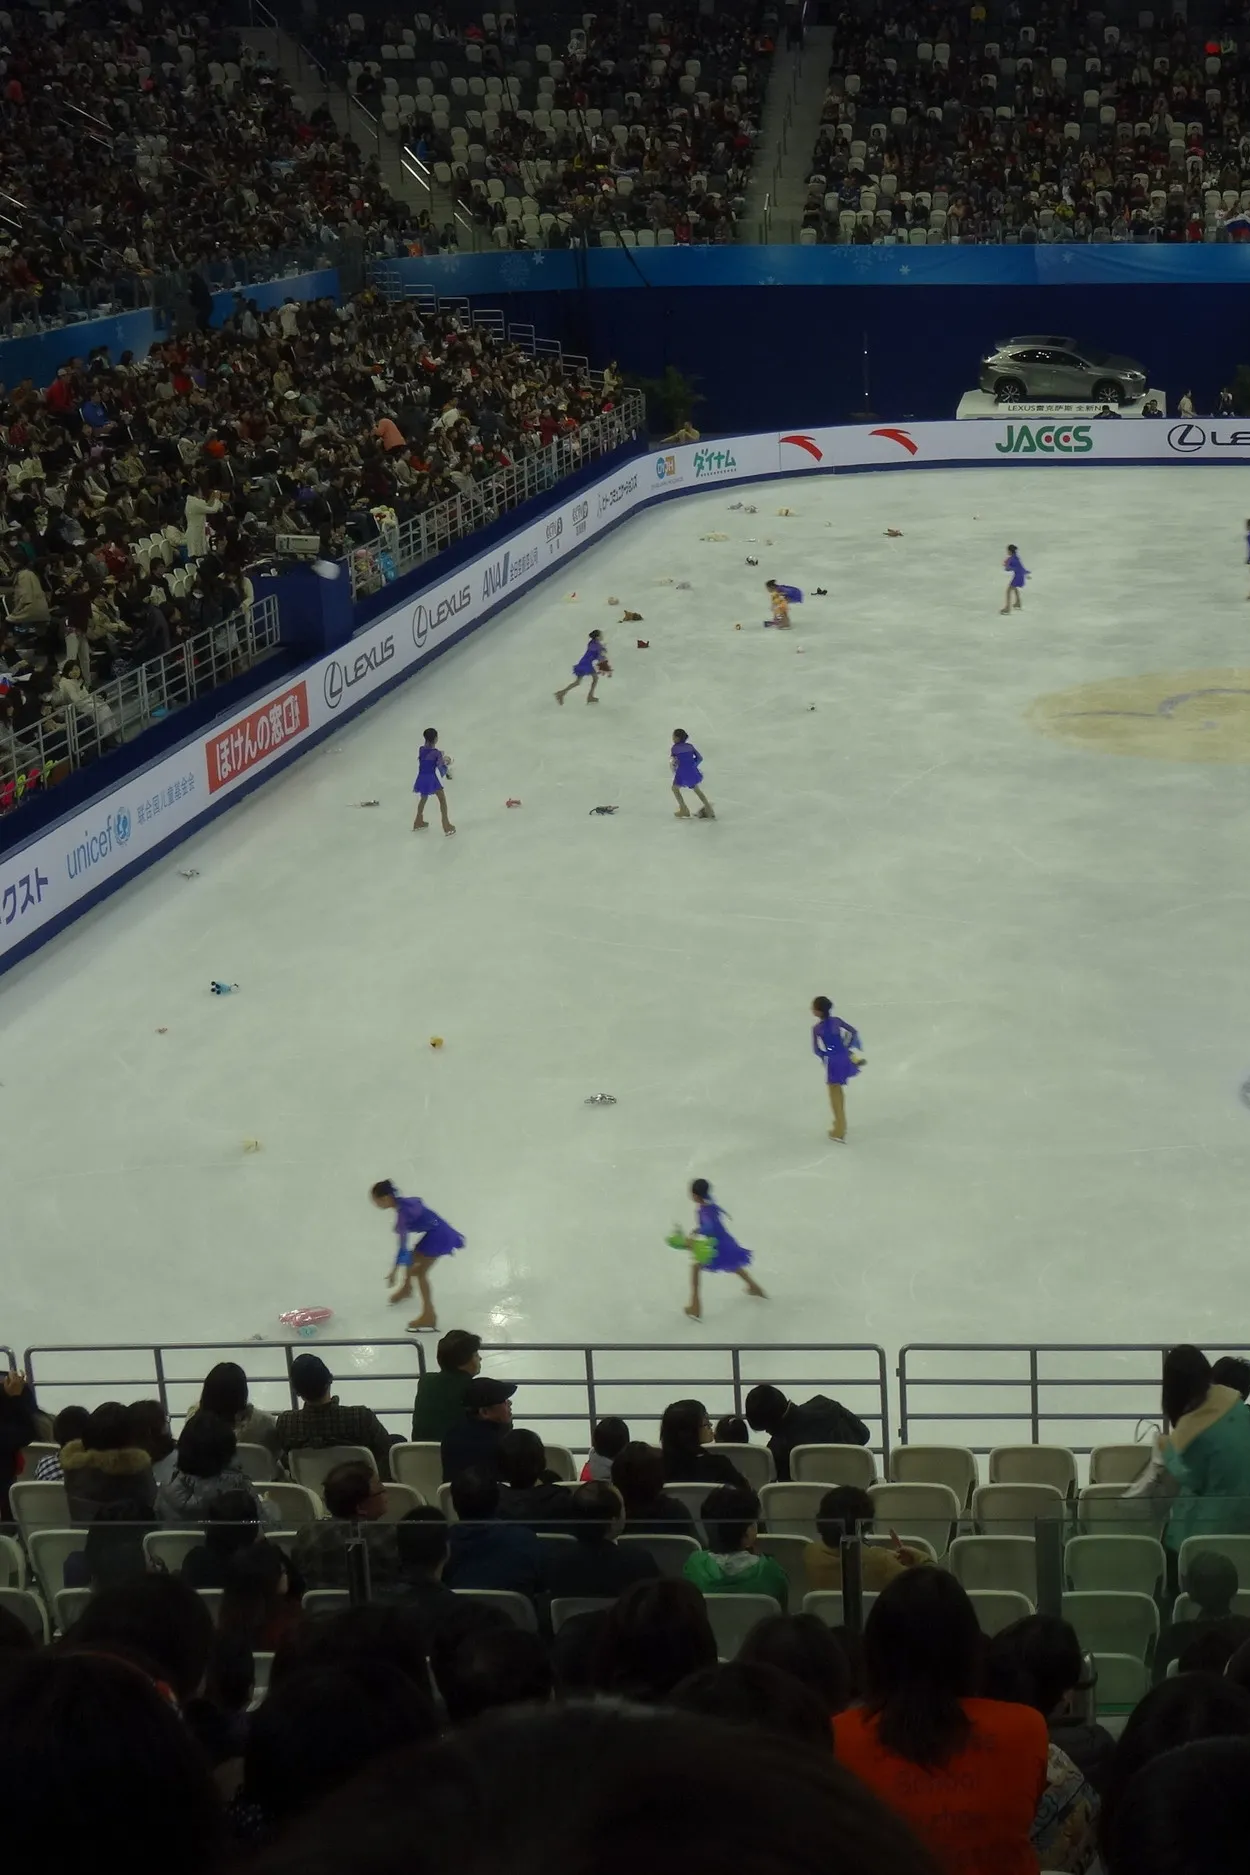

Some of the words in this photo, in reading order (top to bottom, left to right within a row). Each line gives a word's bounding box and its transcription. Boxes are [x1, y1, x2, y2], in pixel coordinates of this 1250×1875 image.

[995, 425, 1093, 453] JACCS
[693, 448, 736, 477] ダイナム
[482, 562, 502, 601] ANA
[428, 585, 472, 631] LEXUS
[343, 635, 395, 688] LEXUS
[64, 825, 114, 880] unicef
[0, 866, 48, 926] クスト
